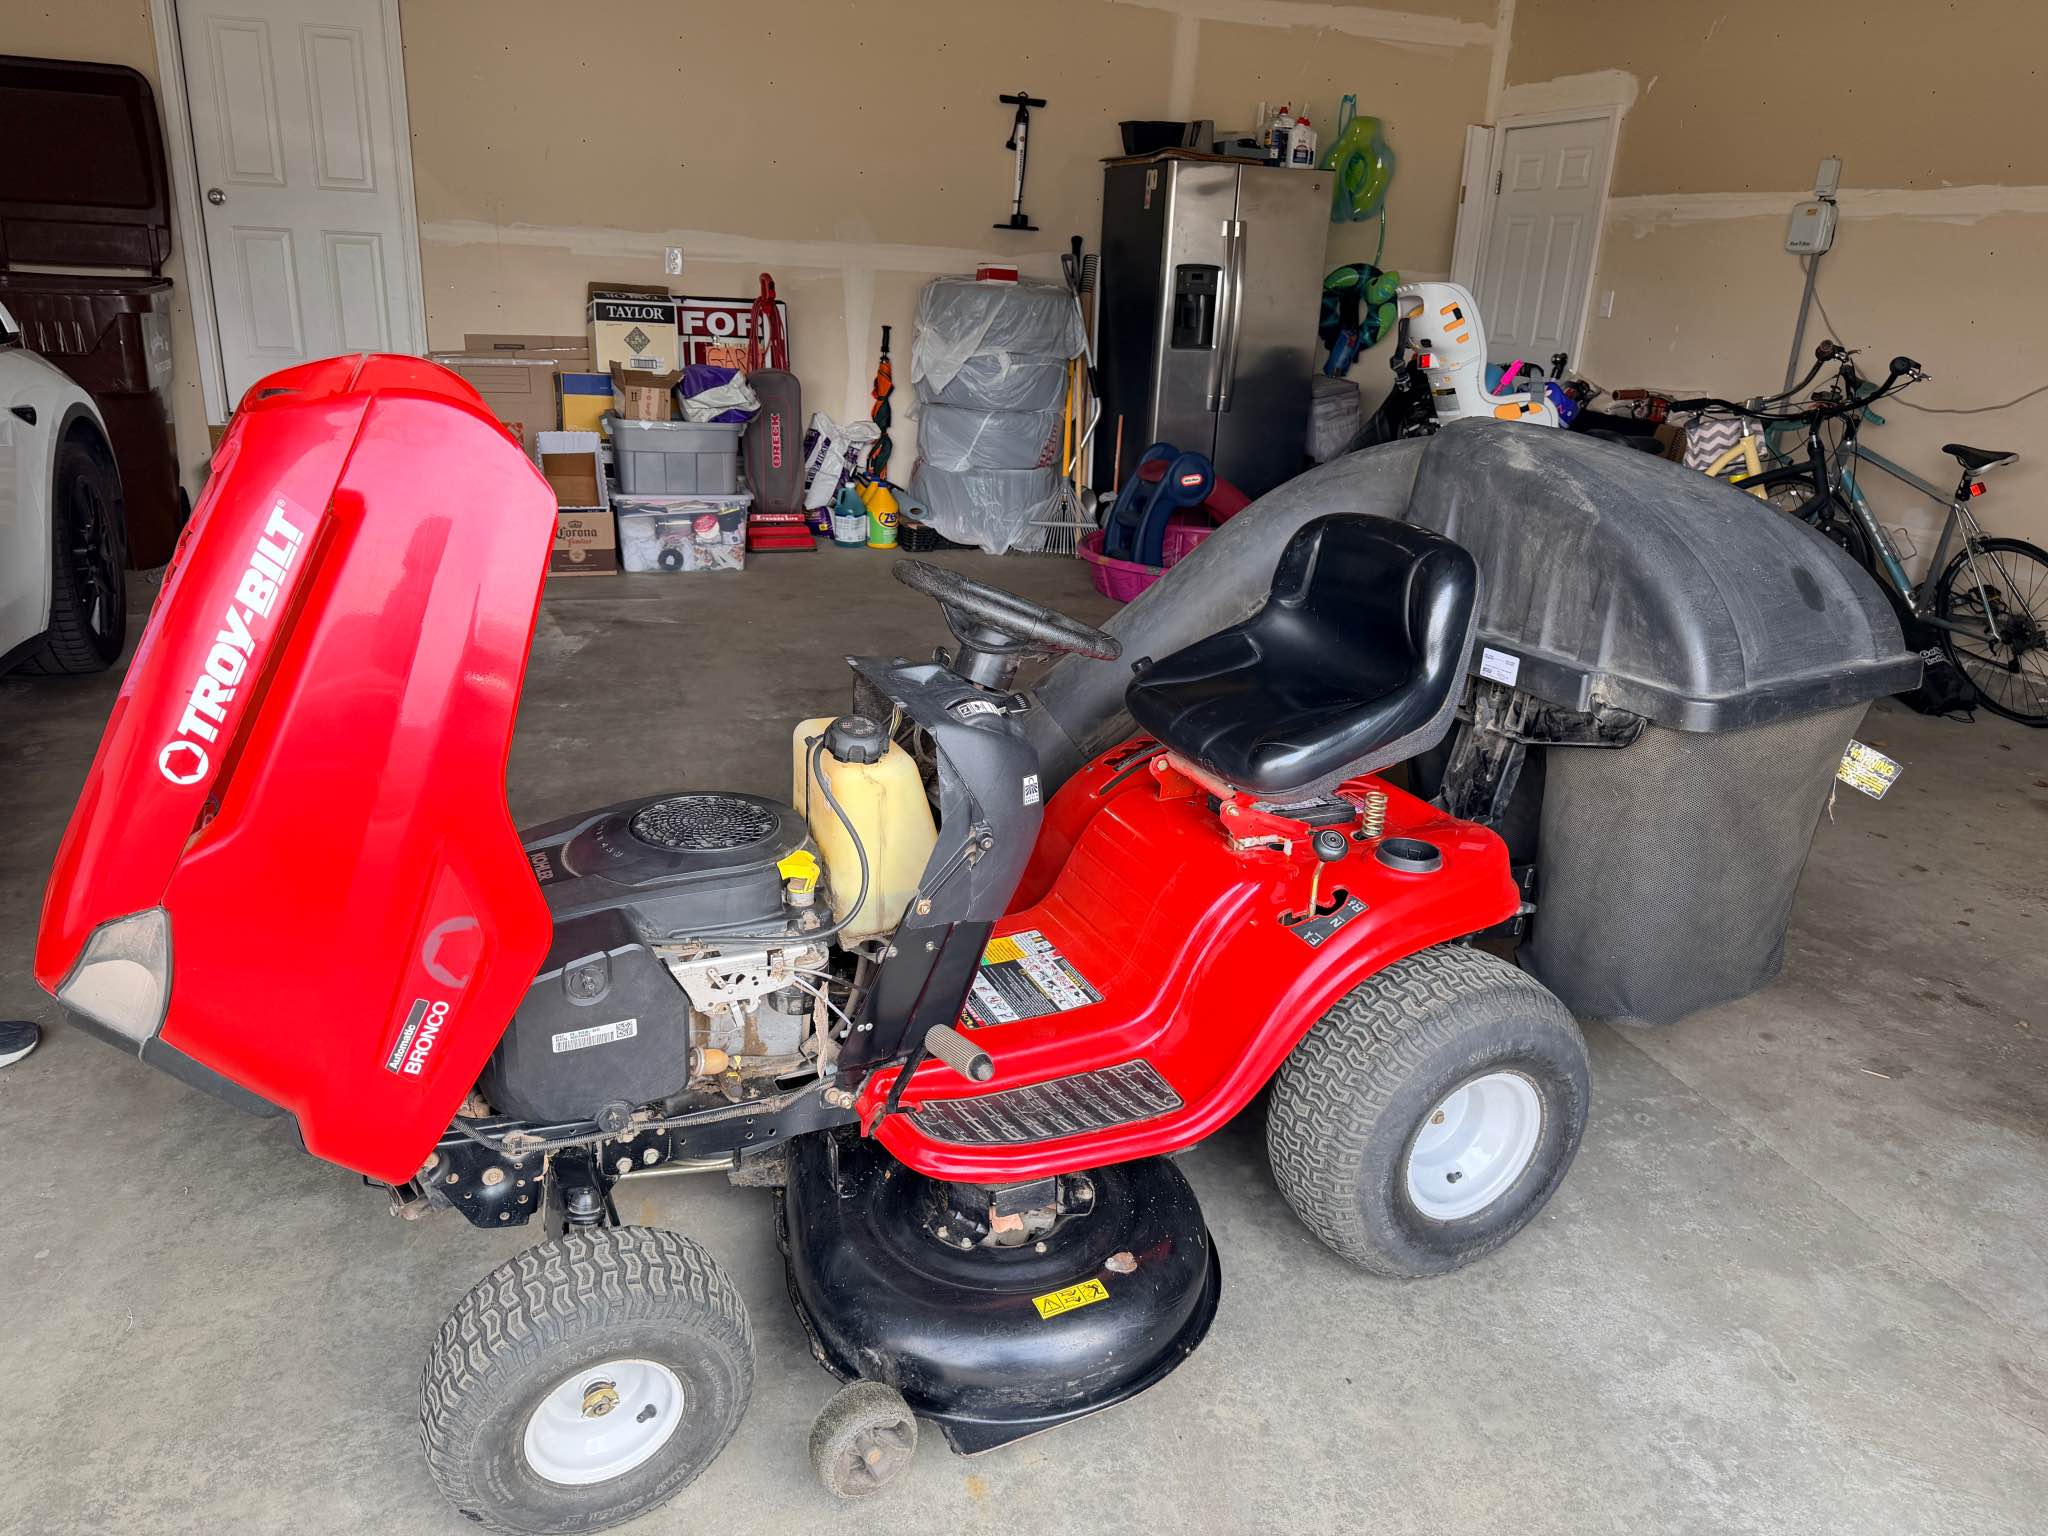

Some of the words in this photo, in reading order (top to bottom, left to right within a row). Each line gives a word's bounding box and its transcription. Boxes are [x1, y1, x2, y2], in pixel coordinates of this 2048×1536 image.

[606, 304, 665, 321] TAYLOR
[681, 310, 764, 337] FOR
[771, 413, 782, 468] ORECK
[556, 526, 597, 540] Corona
[177, 506, 304, 743] TROY-BILT
[530, 852, 554, 881] KOHLER
[1330, 917, 1343, 928] N
[1308, 937, 1321, 946] F
[389, 1024, 416, 1070] Automatic
[404, 1001, 450, 1076] BRONCO
